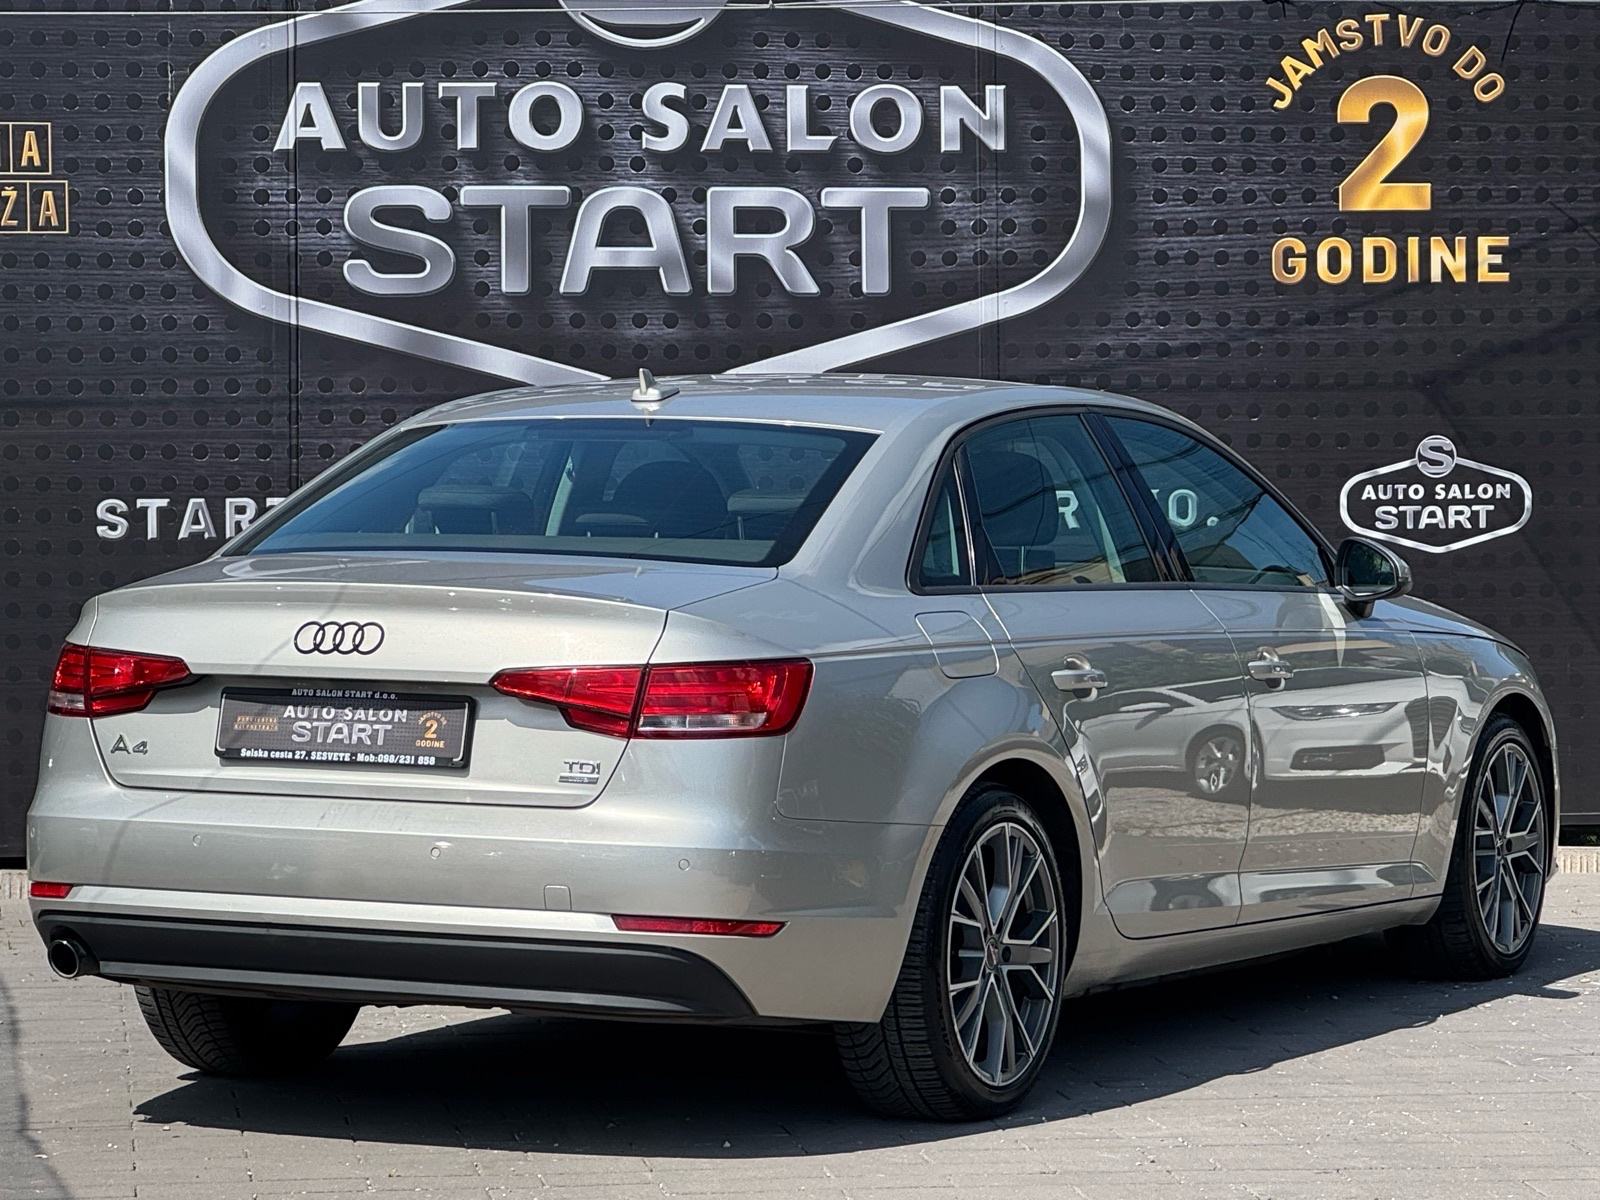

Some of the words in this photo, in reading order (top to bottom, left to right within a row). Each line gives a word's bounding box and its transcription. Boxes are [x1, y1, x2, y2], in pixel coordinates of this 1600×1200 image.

[1265, 13, 1451, 110] JAMSTVO
[1452, 45, 1505, 103] DO
[273, 81, 584, 152] AUTO
[640, 82, 1006, 153] SALON
[1336, 74, 1432, 212] 2
[343, 184, 930, 297] START
[1271, 236, 1510, 284] GODINE
[1361, 484, 1425, 500] AUTO
[1434, 483, 1511, 500] SALON
[1375, 504, 1495, 530] START
[292, 688, 314, 696] AUTO
[315, 689, 343, 697] SALON
[344, 690, 373, 699] START
[374, 691, 398, 700] d.o.o.
[283, 705, 336, 719] AUTO
[343, 706, 408, 723] SALON
[291, 721, 393, 746] START
[424, 719, 438, 739] 2
[110, 734, 148, 755] A4
[415, 739, 446, 749] GODINE
[270, 750, 293, 759] cesta
[310, 751, 351, 762] SESVETE
[417, 755, 436, 766] 858
[563, 761, 600, 775] TDI
